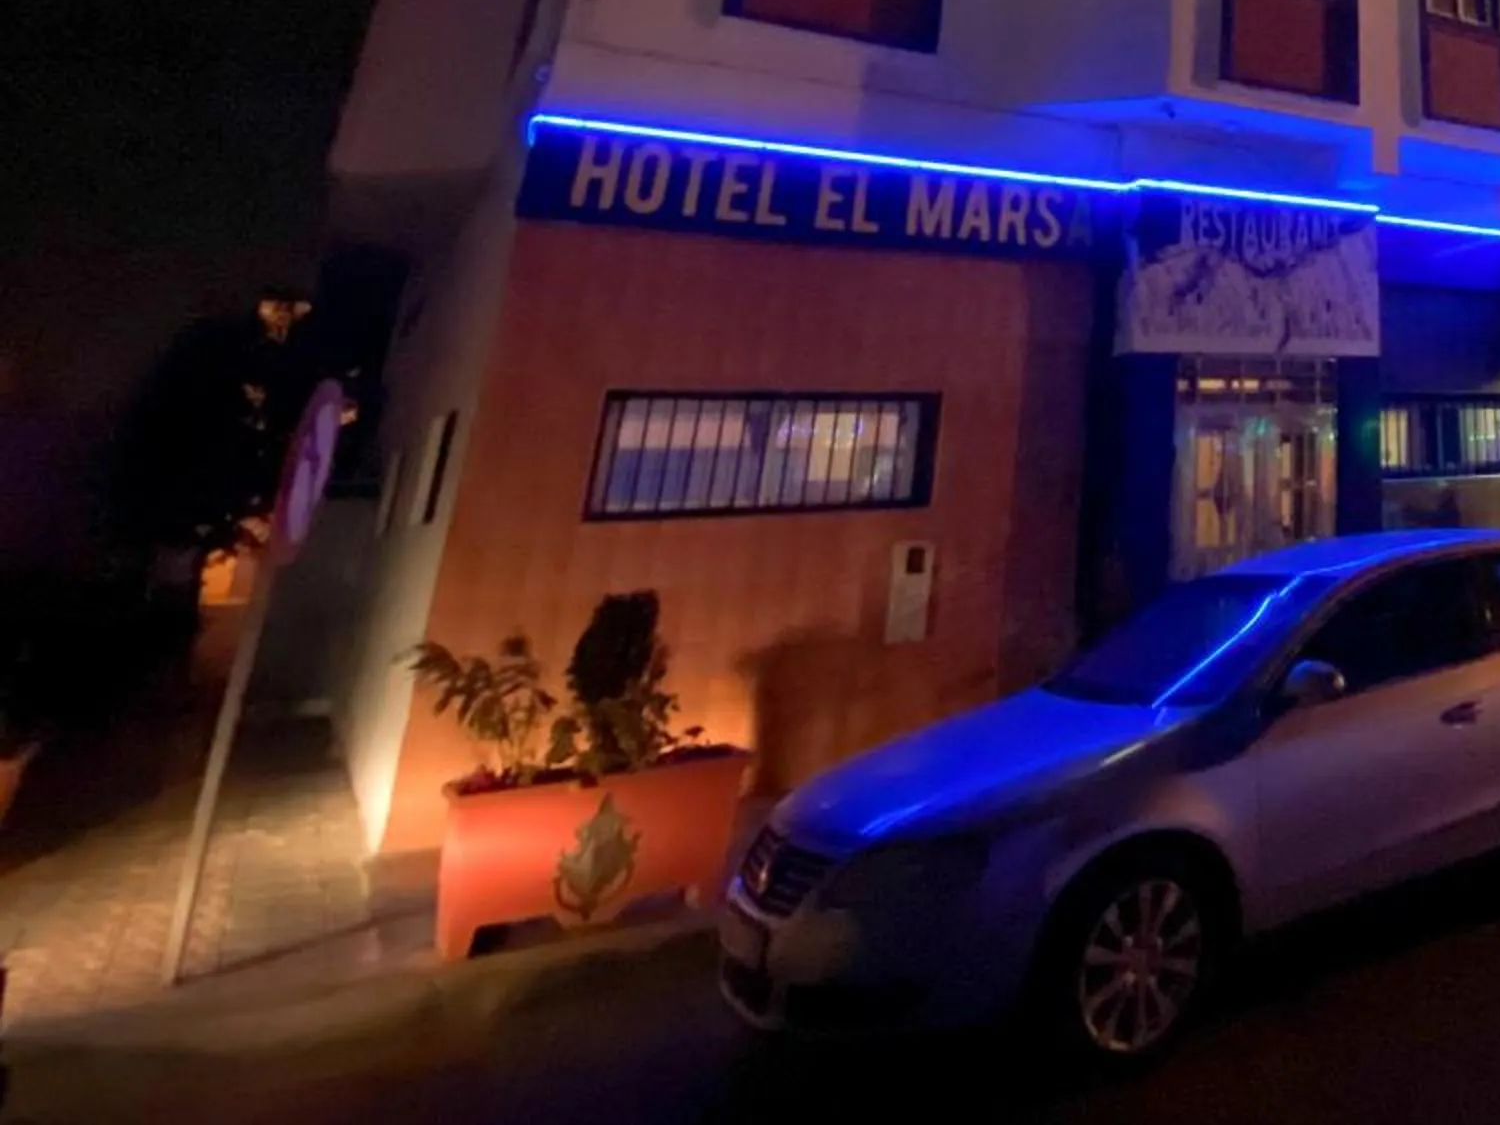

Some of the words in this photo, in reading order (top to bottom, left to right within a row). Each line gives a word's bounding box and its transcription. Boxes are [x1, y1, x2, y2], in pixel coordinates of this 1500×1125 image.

[568, 134, 787, 227] HOTEL
[813, 163, 880, 234] EL
[904, 175, 1094, 249] MARSA
[1180, 197, 1341, 259] RESTAURANT
